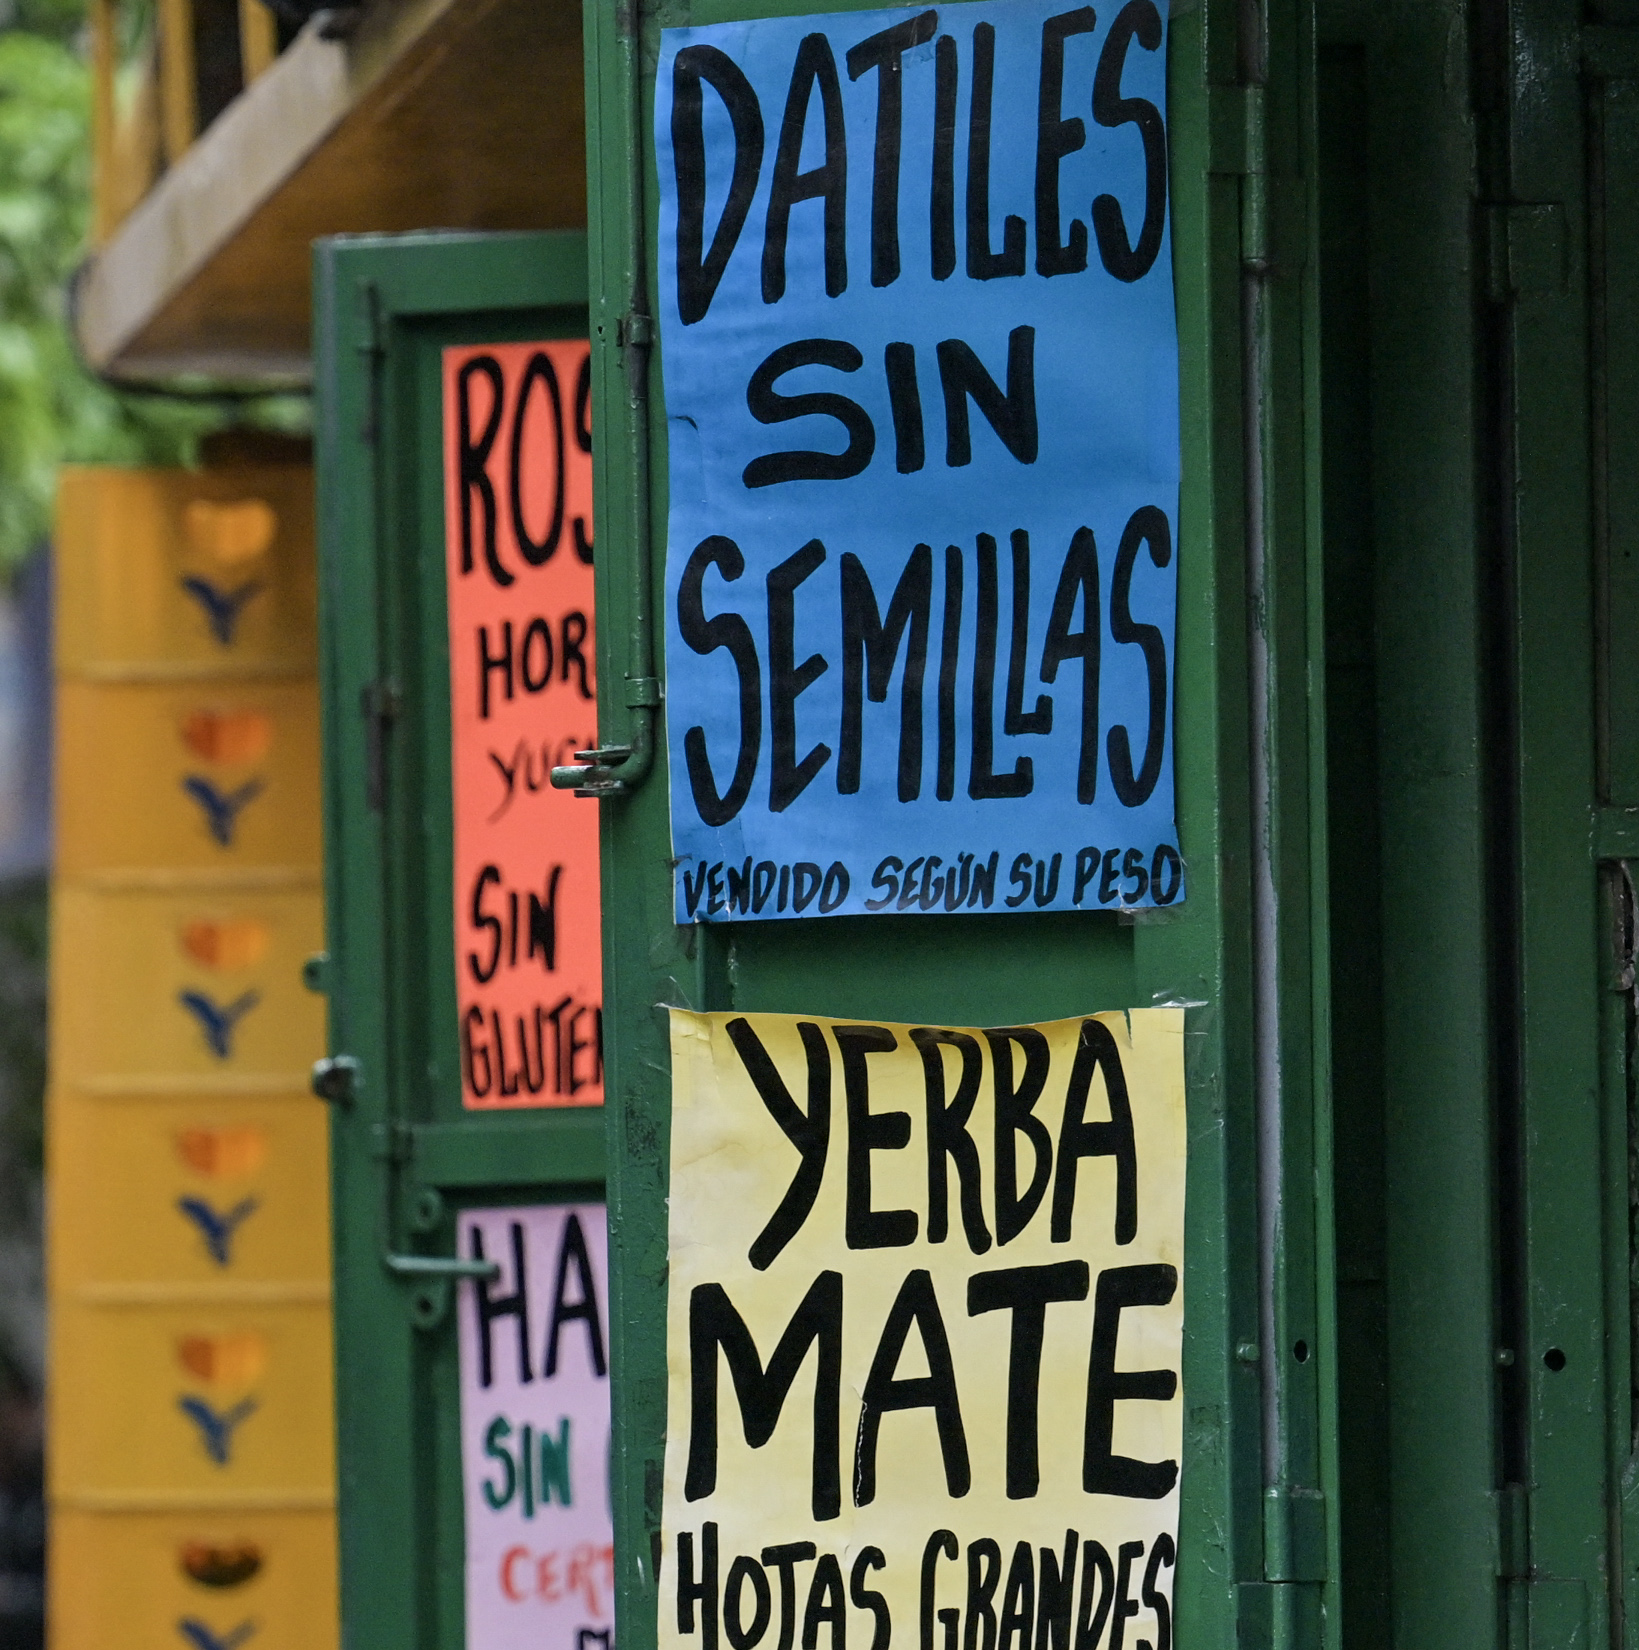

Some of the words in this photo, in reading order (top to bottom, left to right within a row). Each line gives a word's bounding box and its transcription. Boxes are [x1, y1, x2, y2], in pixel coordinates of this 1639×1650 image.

[671, 0, 1166, 325] DATILES
[742, 325, 1038, 488] SIN
[676, 505, 1171, 827] SEMILLAS
[469, 864, 564, 983] SIN
[684, 855, 849, 916] VENDIDO
[1003, 852, 1061, 908] SU
[1072, 844, 1182, 907] PESO
[726, 1018, 1138, 1270] YERBA
[483, 1415, 574, 1519] SIN
[685, 1260, 1178, 1521] MATE
